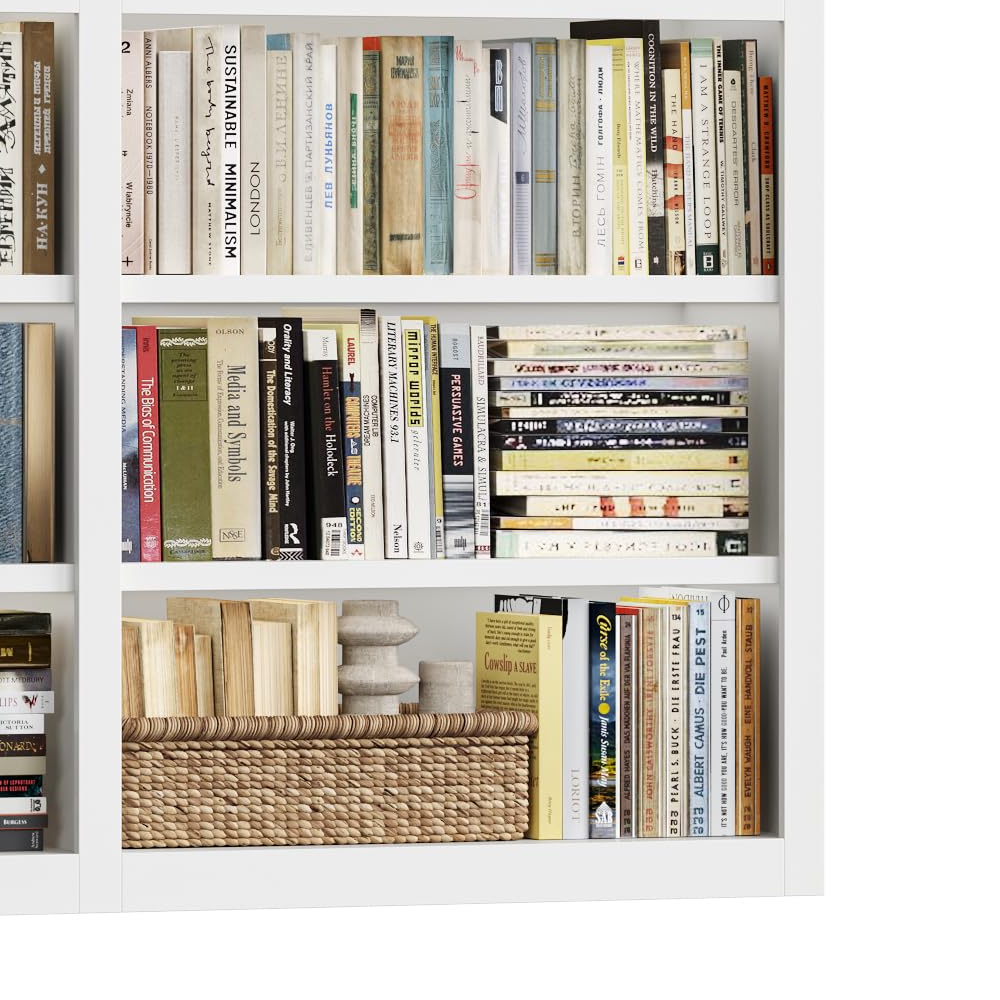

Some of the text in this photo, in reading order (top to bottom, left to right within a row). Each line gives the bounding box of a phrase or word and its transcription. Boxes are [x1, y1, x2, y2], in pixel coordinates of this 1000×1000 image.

[648, 34, 656, 88] COGNITION
[701, 78, 708, 96] AM
[650, 91, 656, 102] IN
[702, 104, 708, 112] A
[225, 46, 236, 258] SUSTAINABLE MINIMALISM
[702, 120, 710, 188] STRANGE
[250, 162, 260, 235] LONDON
[704, 197, 712, 238] LOOP
[282, 324, 292, 405] Orality and Literacy
[387, 322, 399, 442] LITERARY MACHINES 93.1
[408, 332, 421, 424] mirror worlds
[142, 377, 155, 502] The Bias of Communication
[225, 366, 247, 482] Media and Symbols
[322, 368, 336, 476] Hamlet on the Holodeck
[452, 375, 463, 466] PERSUASIVE GAMES
[394, 525, 402, 552] Nelson
[485, 652, 536, 675] Cowslip A SLAVE
[597, 614, 612, 700] Curse of the Exile
[672, 629, 680, 655] FRAU
[672, 662, 680, 690] ERSTE
[672, 698, 680, 712] DIE
[694, 628, 706, 797] ALBERT CAMUS DIE PEST
[599, 716, 611, 788] Janis Susan May
[671, 728, 679, 754] BUCK
[671, 772, 679, 802] PEARL
